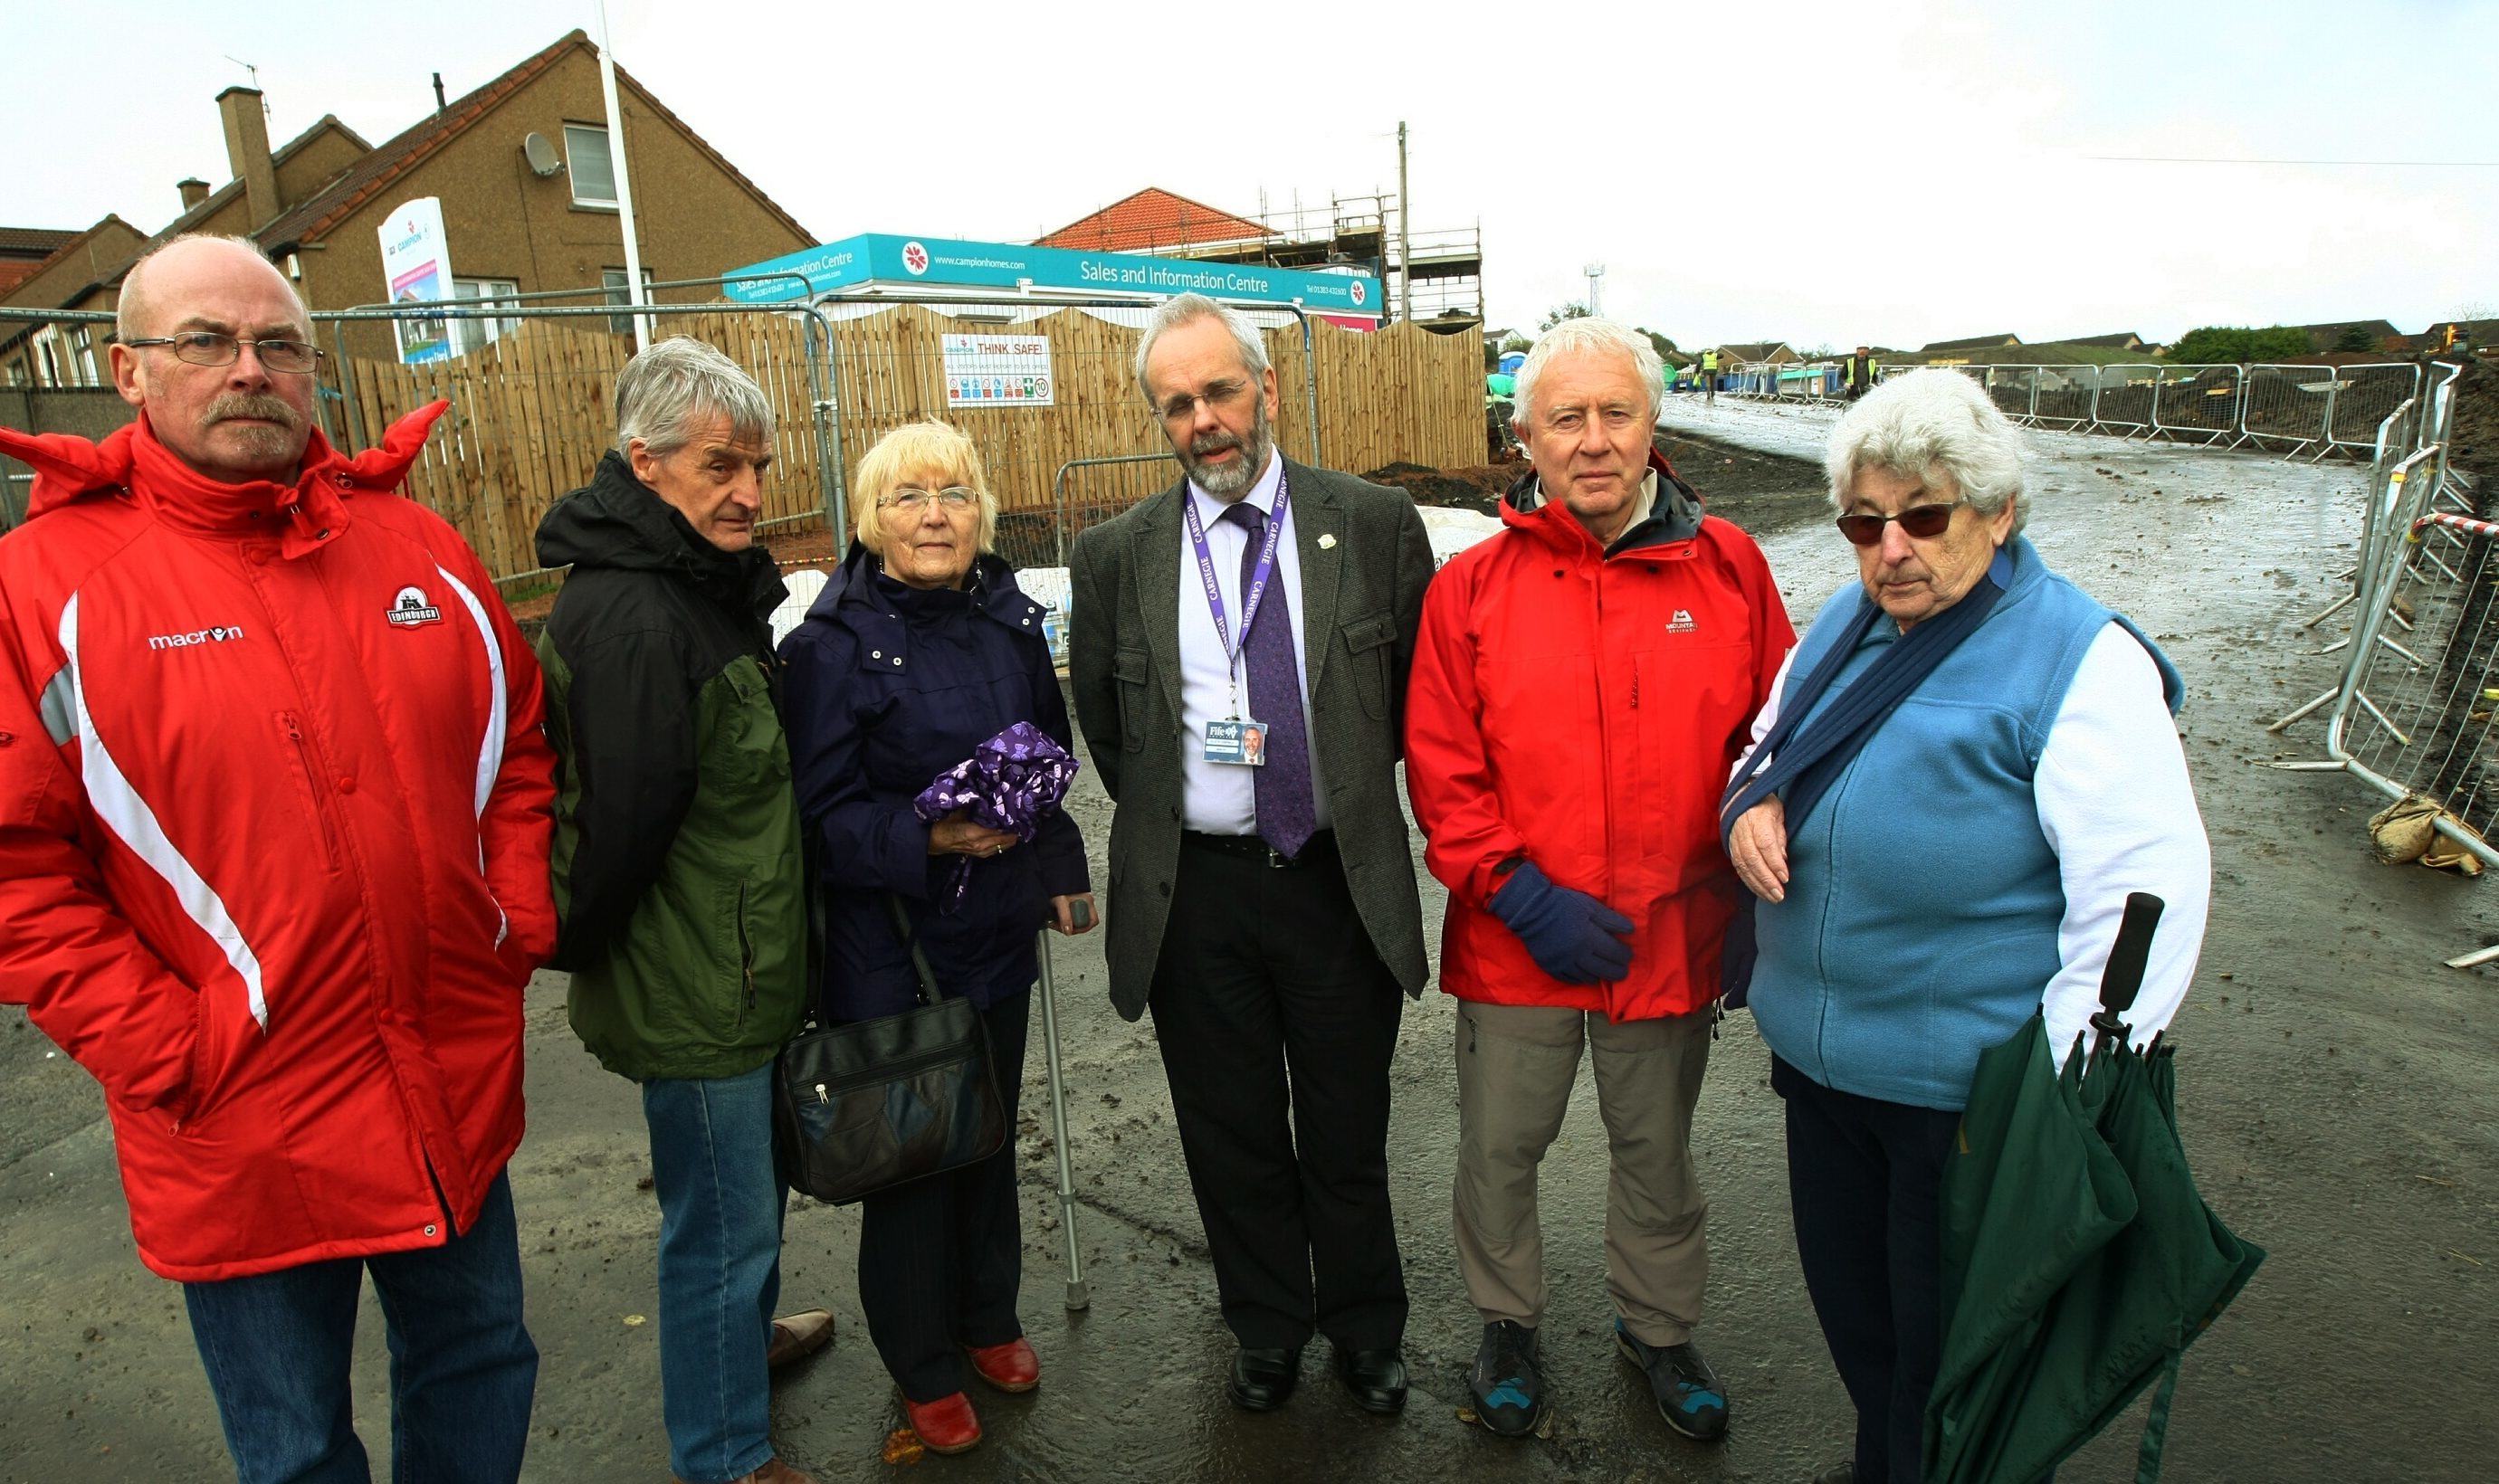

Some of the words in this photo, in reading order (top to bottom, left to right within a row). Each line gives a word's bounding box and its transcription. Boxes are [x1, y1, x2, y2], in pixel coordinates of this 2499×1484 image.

[821, 252, 854, 270] Centre
[934, 256, 1025, 270] www.campionhomes.com
[1081, 261, 1118, 281] Sales
[1121, 265, 1146, 284] and
[1149, 266, 1225, 290] Information
[1226, 273, 1268, 292] Centre
[978, 343, 1009, 355] THINK
[1014, 343, 1044, 356] SAFE!
[1036, 382, 1046, 392] 10
[1188, 501, 1203, 544] CARNEGIE
[1261, 521, 1280, 566] CARNEGIE
[1200, 556, 1218, 601] CARNEGIE
[1242, 580, 1263, 629] CARNEGIE
[390, 609, 436, 622] EDINBURGH
[148, 626, 244, 651] macron
[1209, 726, 1225, 737] Fife
